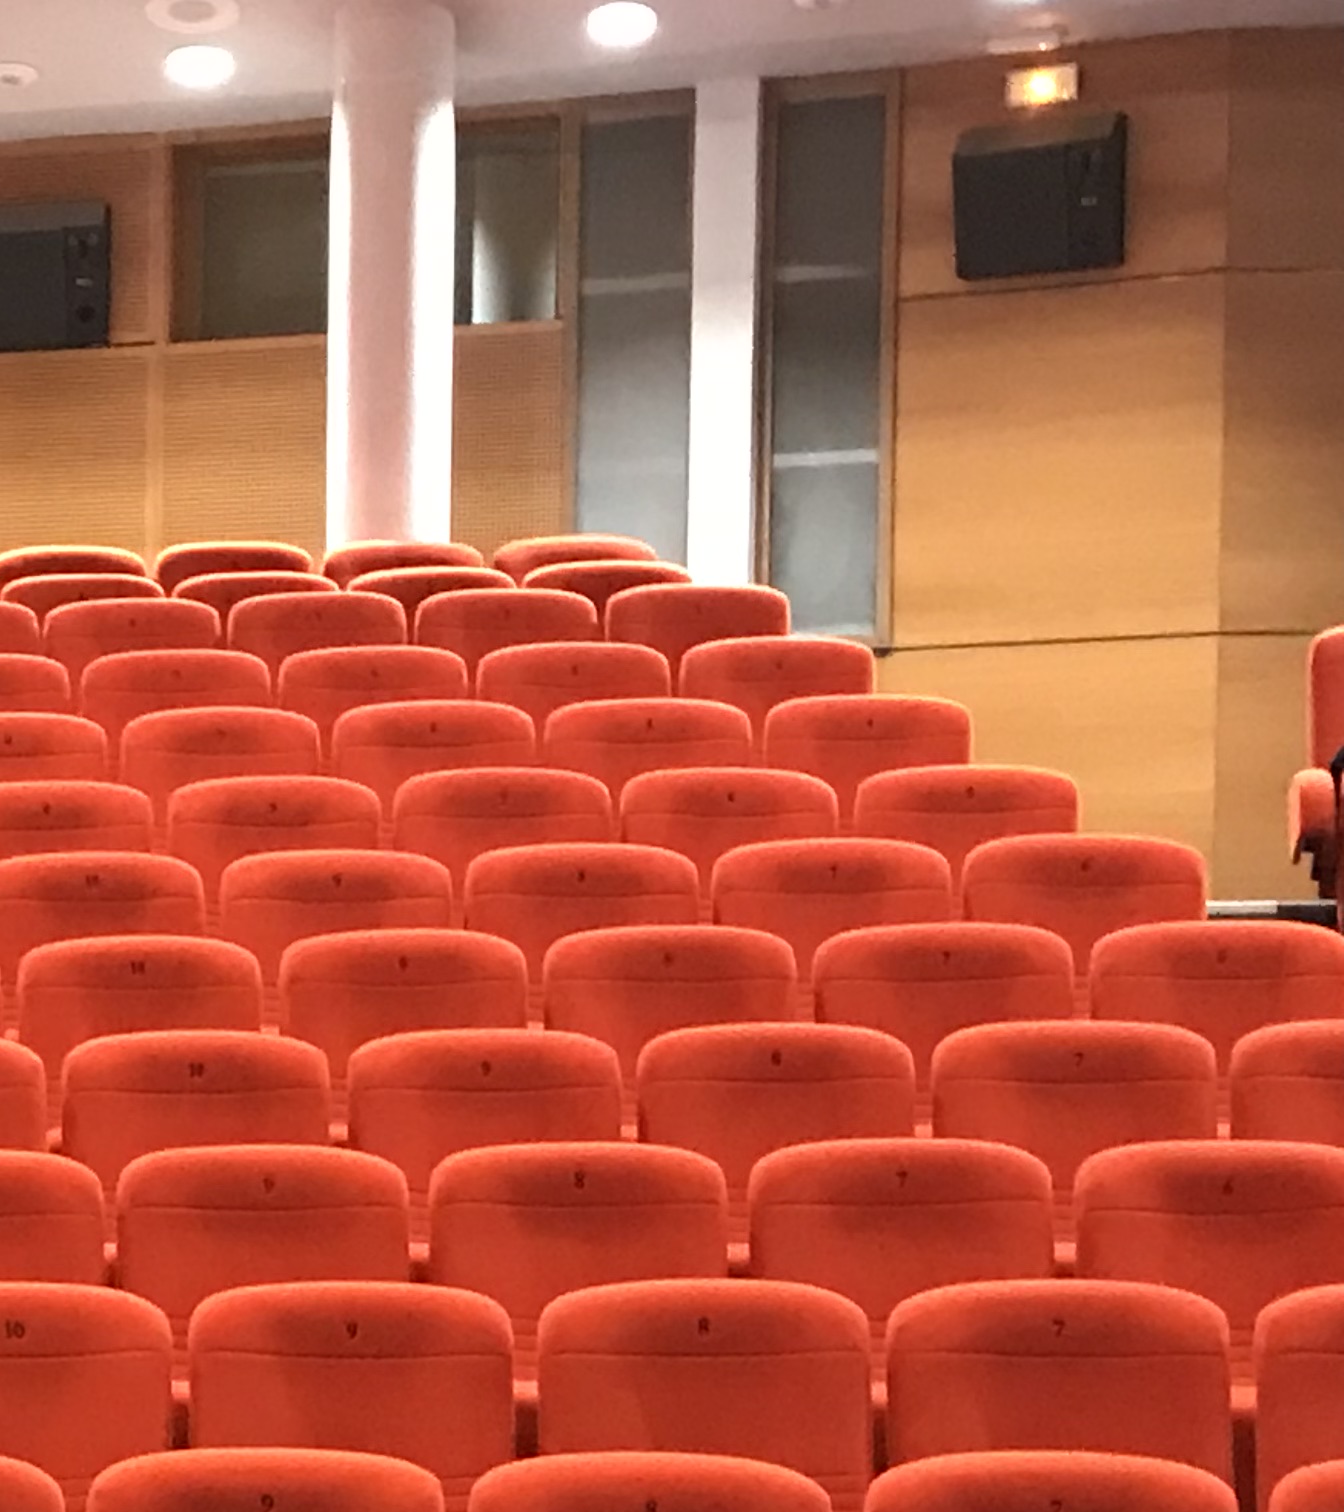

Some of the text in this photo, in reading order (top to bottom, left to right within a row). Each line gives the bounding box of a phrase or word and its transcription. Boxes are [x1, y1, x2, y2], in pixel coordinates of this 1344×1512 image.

[4, 1319, 26, 1339] 10
[343, 1320, 359, 1339] 9
[1052, 1317, 1066, 1336] 7
[259, 1493, 275, 1511] 9
